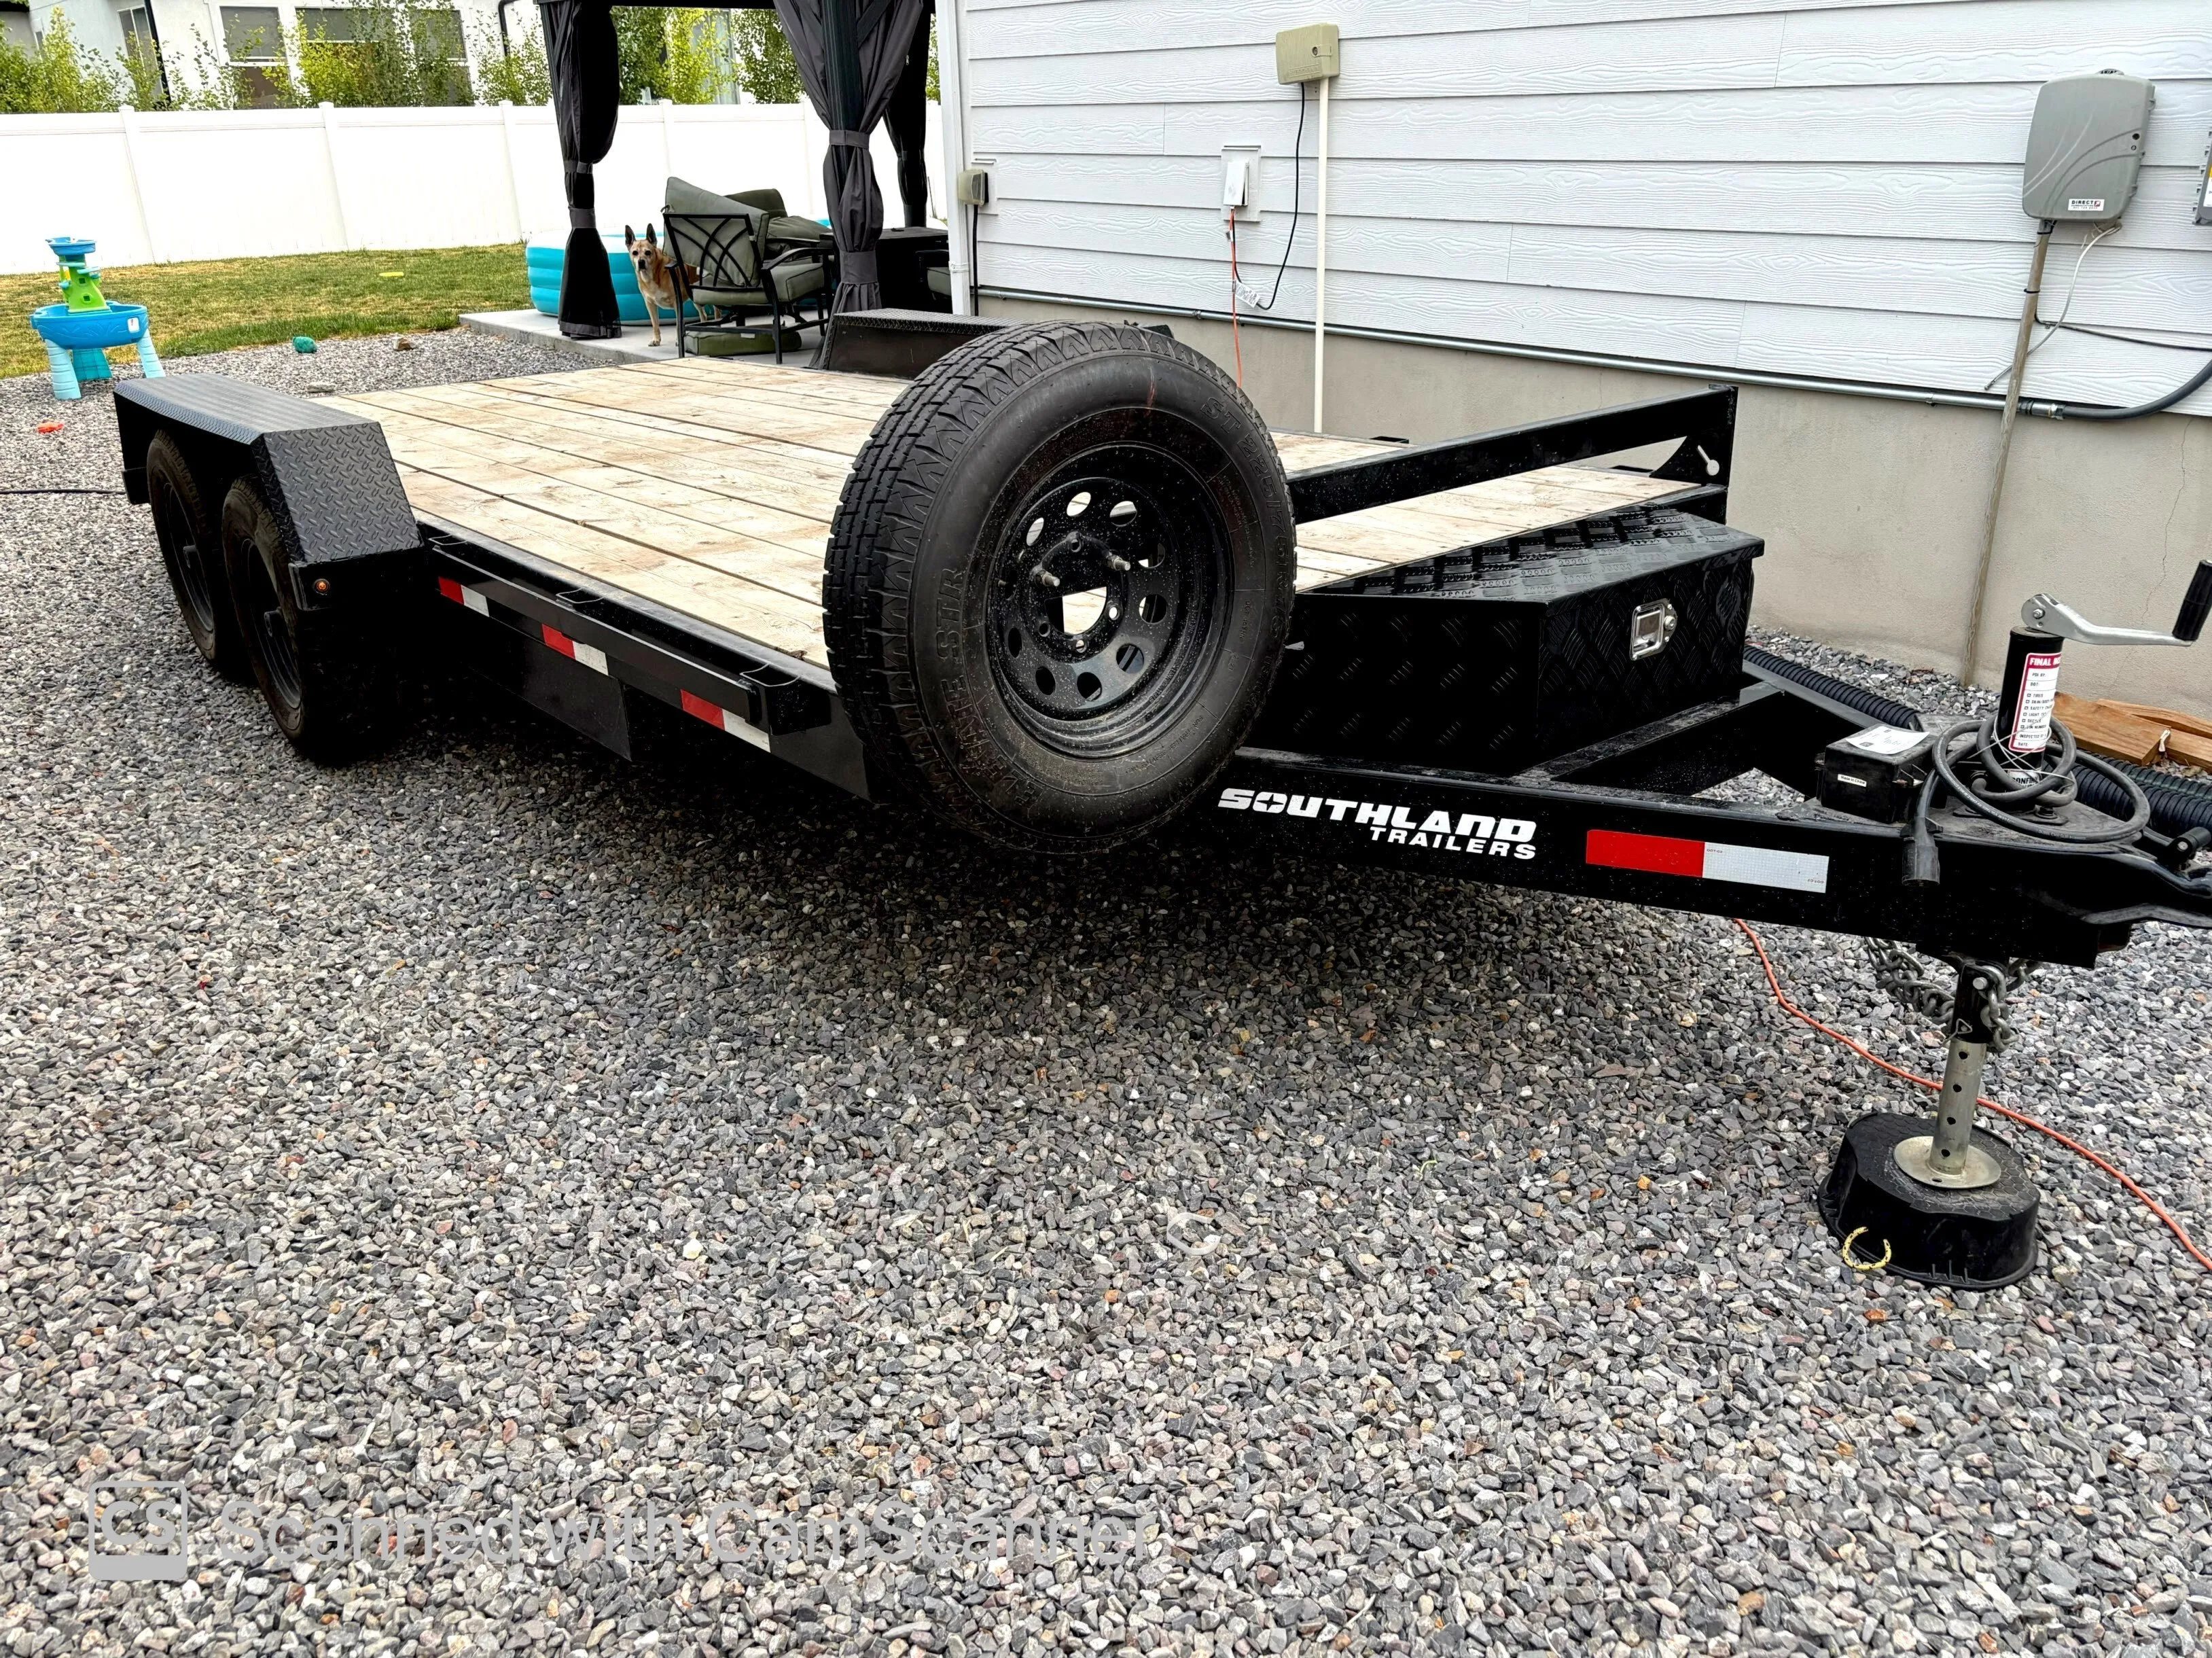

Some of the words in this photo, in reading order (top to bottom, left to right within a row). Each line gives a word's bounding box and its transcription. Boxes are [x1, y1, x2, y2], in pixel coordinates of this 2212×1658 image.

[2029, 657, 2051, 666] FINAL
[1218, 788, 1537, 843] SOUTHLAND
[1370, 826, 1537, 860] TRAILERS
